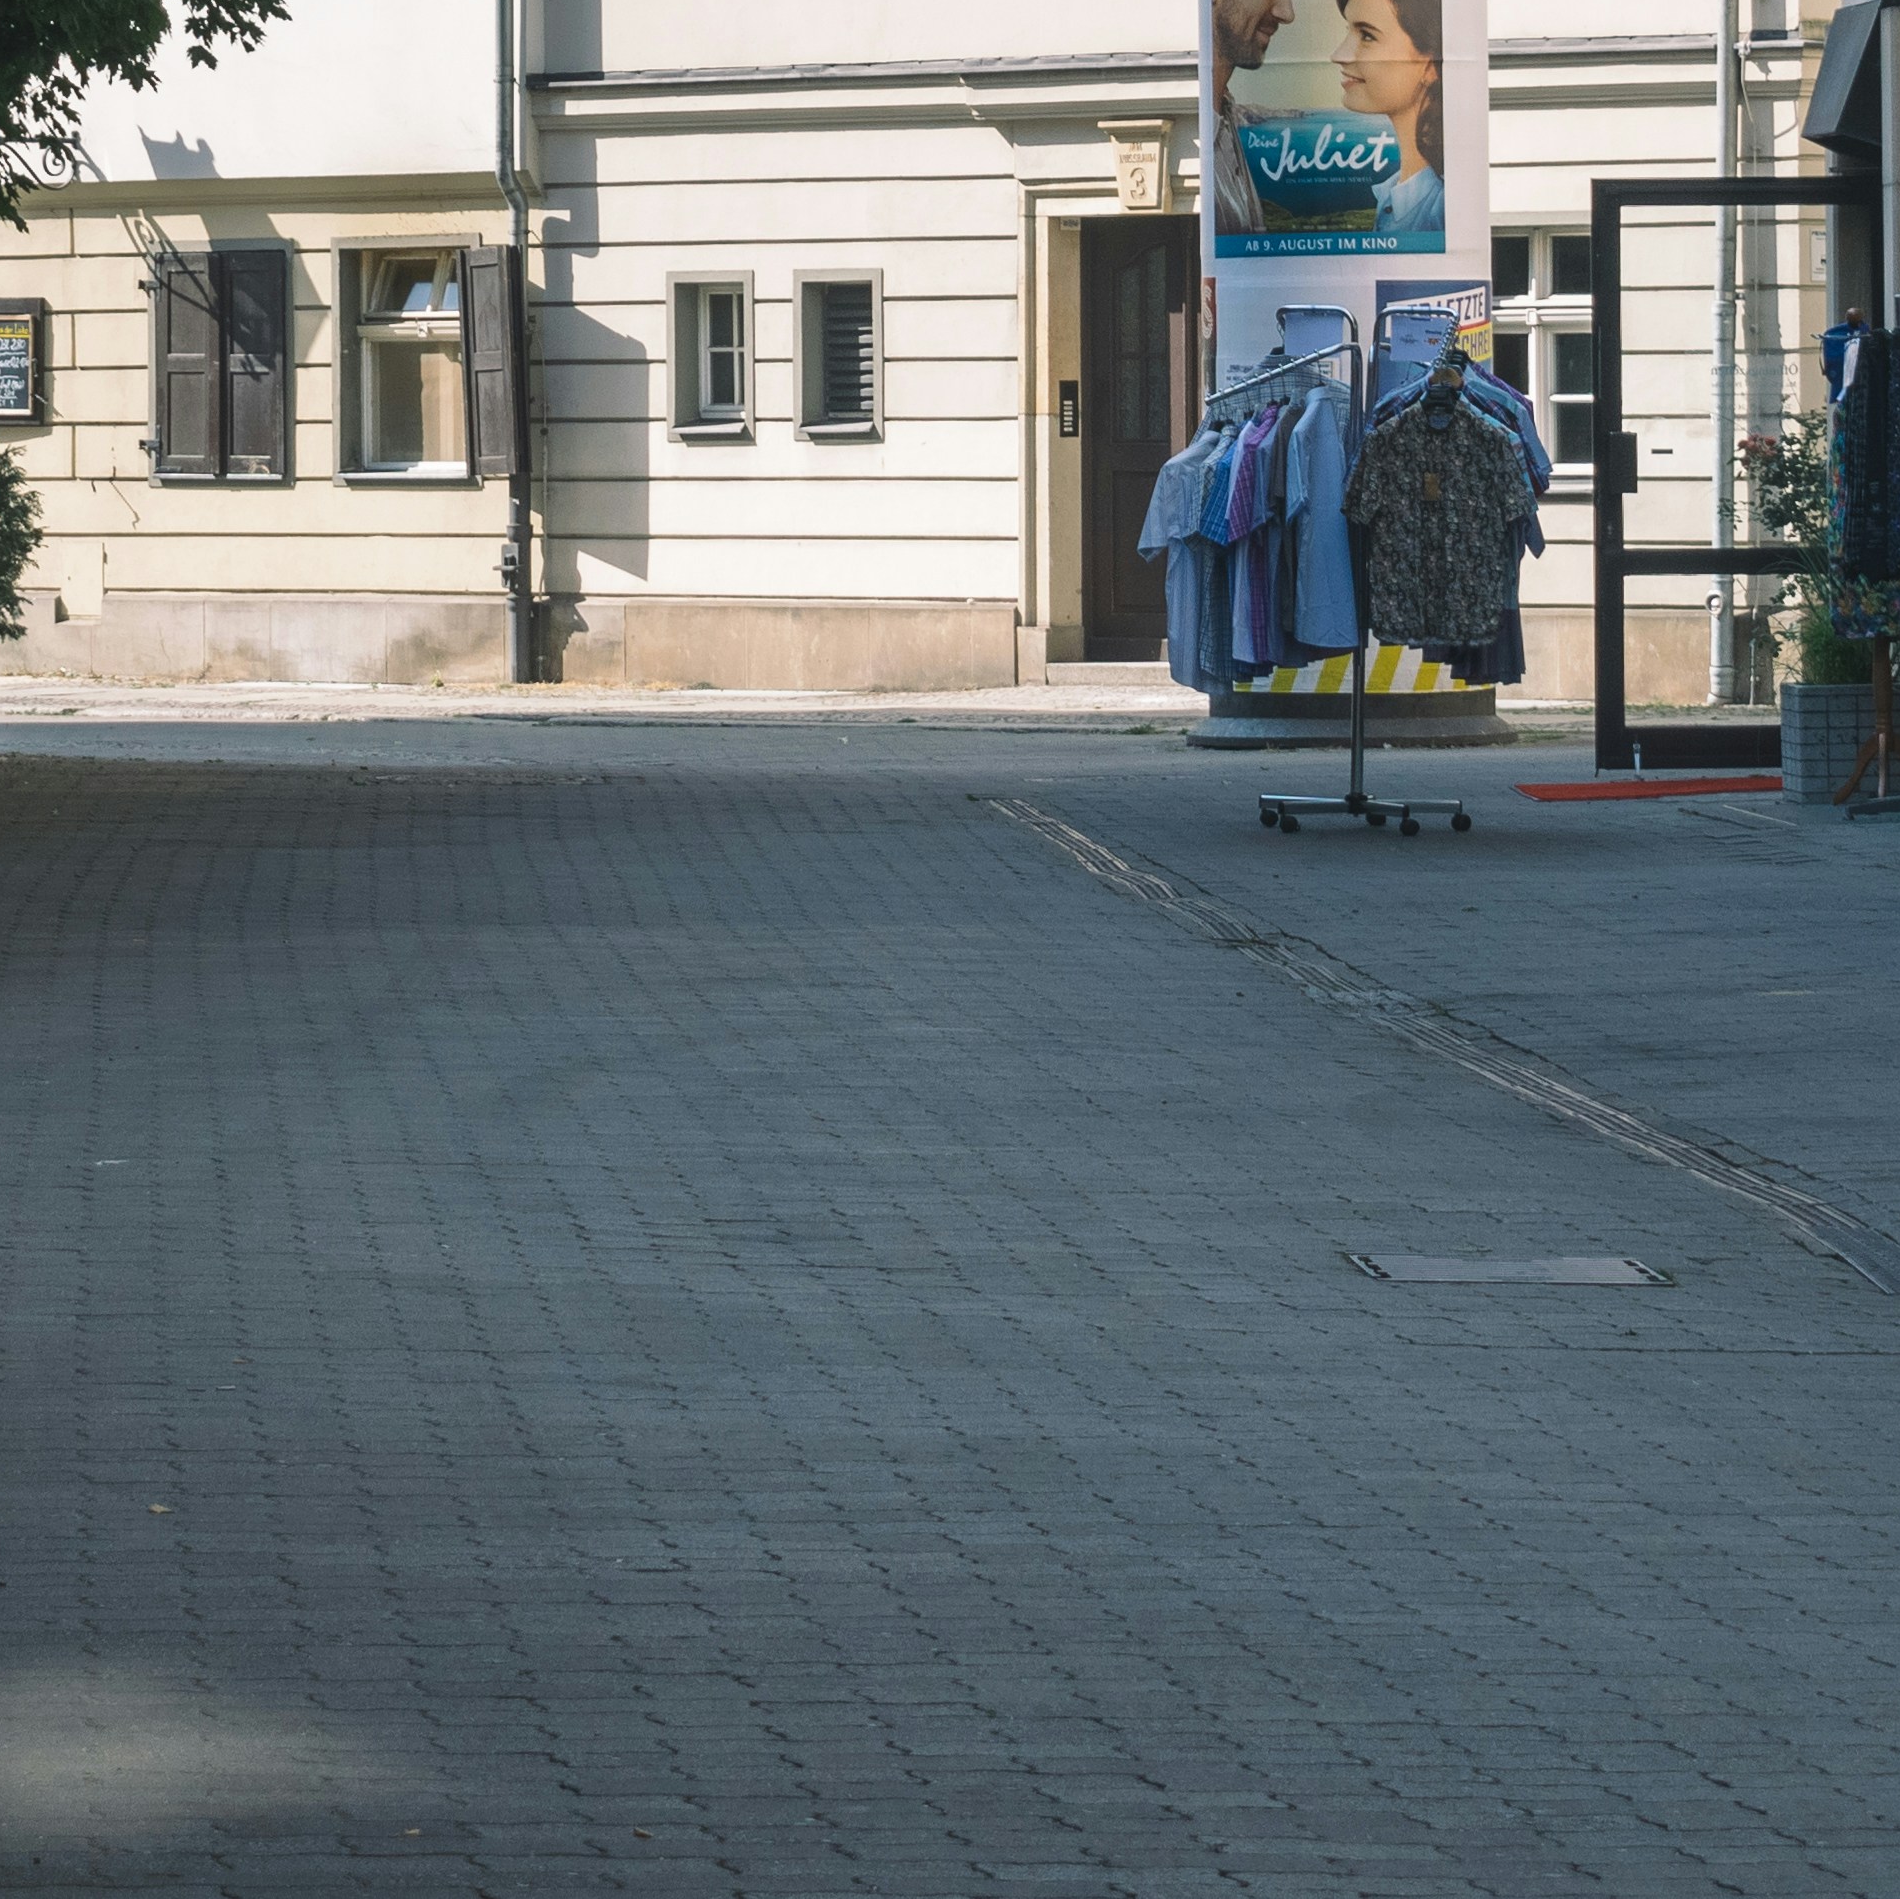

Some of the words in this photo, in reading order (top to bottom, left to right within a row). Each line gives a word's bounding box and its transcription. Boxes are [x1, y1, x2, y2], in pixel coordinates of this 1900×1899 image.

[1248, 131, 1279, 148] Deine
[1260, 124, 1395, 181] Juliet
[1130, 167, 1146, 199] 3
[1245, 240, 1259, 251] AB
[1263, 240, 1274, 251] 9.
[1278, 239, 1333, 250] AUGUST
[1338, 238, 1356, 249] IM
[1362, 237, 1397, 249] KINO
